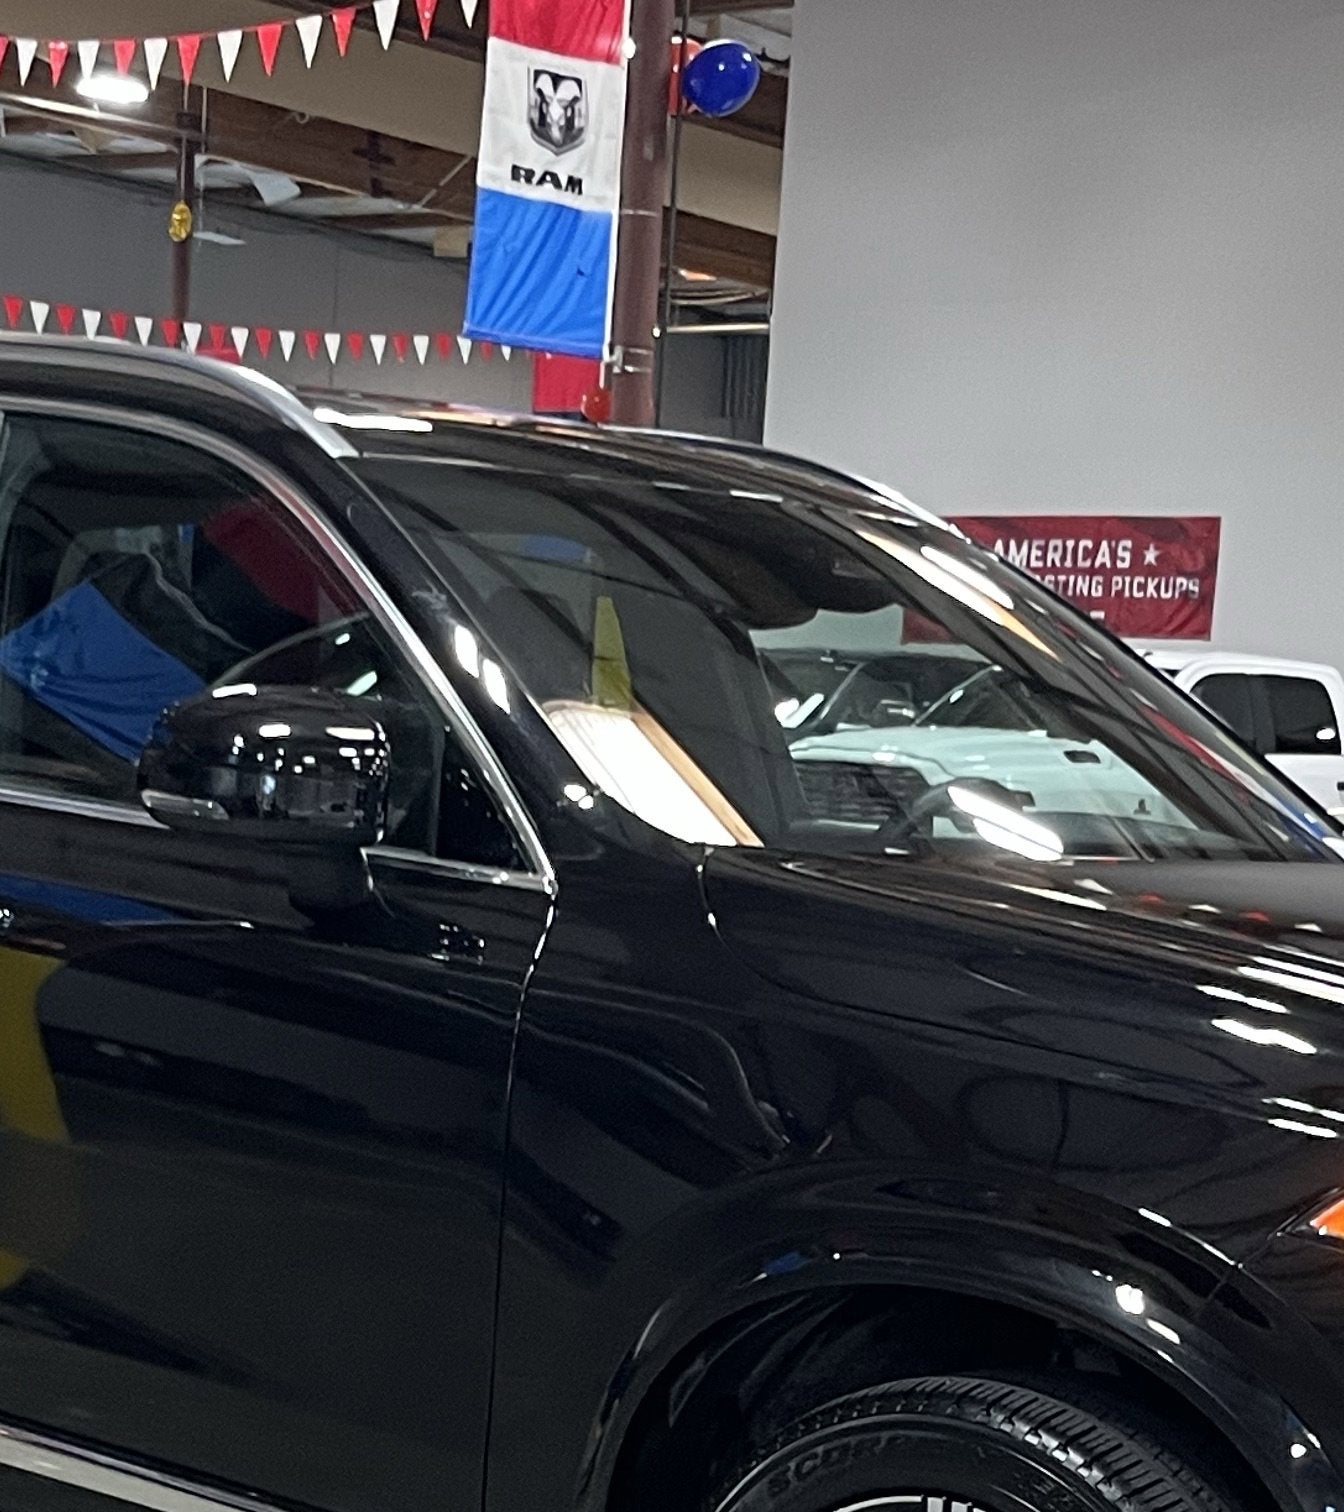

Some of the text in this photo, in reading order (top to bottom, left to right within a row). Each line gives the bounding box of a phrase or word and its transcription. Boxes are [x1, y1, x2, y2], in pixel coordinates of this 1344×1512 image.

[511, 164, 583, 195] RAM
[994, 539, 1133, 569] AMERICA'S
[1111, 575, 1199, 599] PICKUPS
